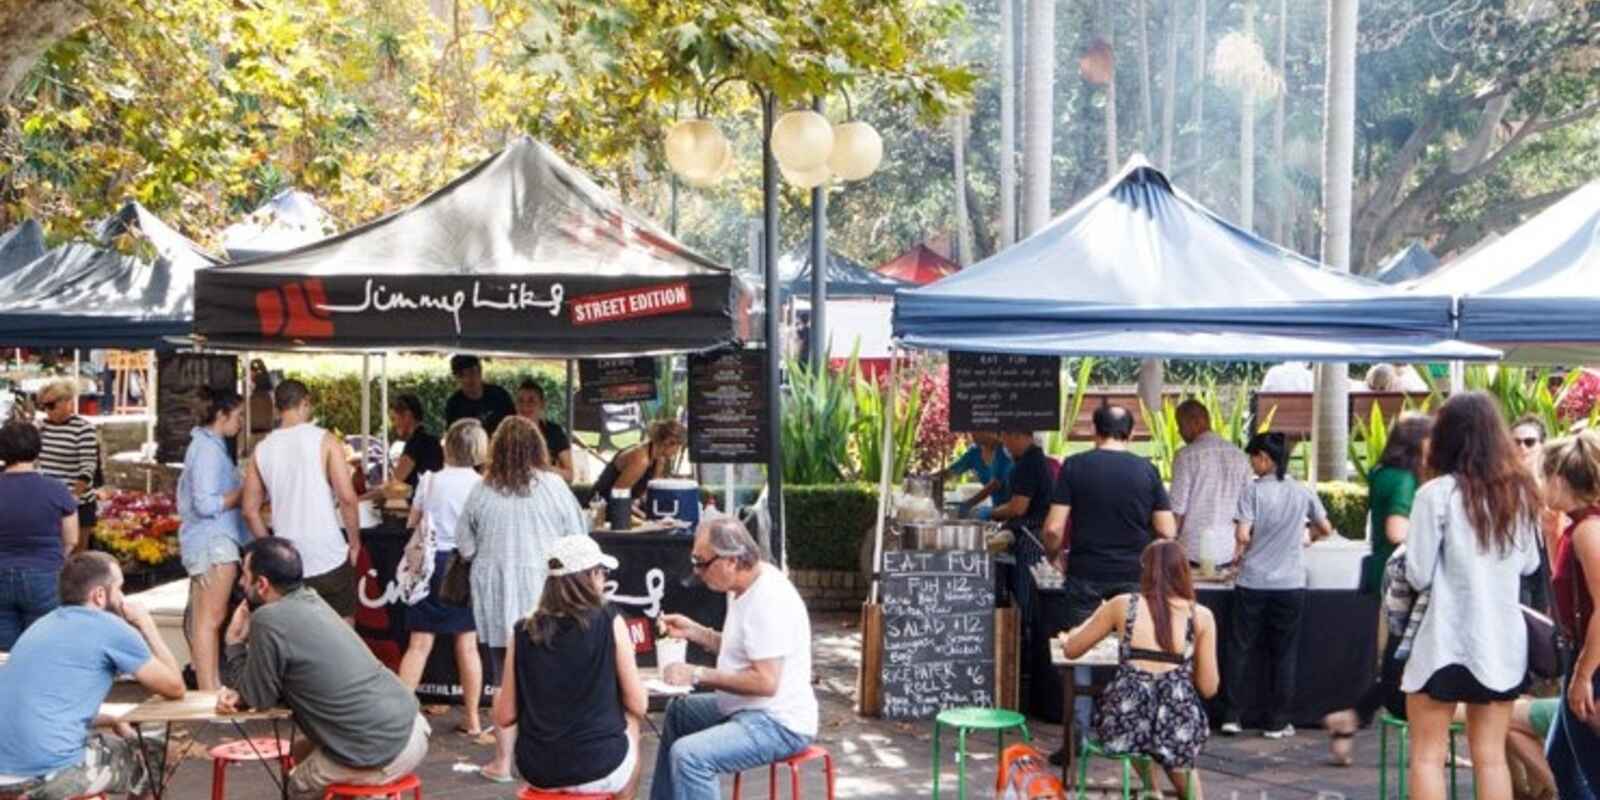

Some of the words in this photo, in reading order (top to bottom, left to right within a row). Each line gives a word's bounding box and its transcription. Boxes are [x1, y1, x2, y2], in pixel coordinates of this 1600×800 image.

[315, 278, 465, 334] Jimmy
[575, 297, 627, 322] STREET
[629, 286, 687, 312] EDITION
[883, 551, 934, 572] EAT
[947, 550, 989, 580] FUH
[907, 577, 940, 595] FUH
[887, 615, 946, 637] SALAD
[913, 661, 958, 681] PAPER
[903, 678, 953, 696] ROLLS
